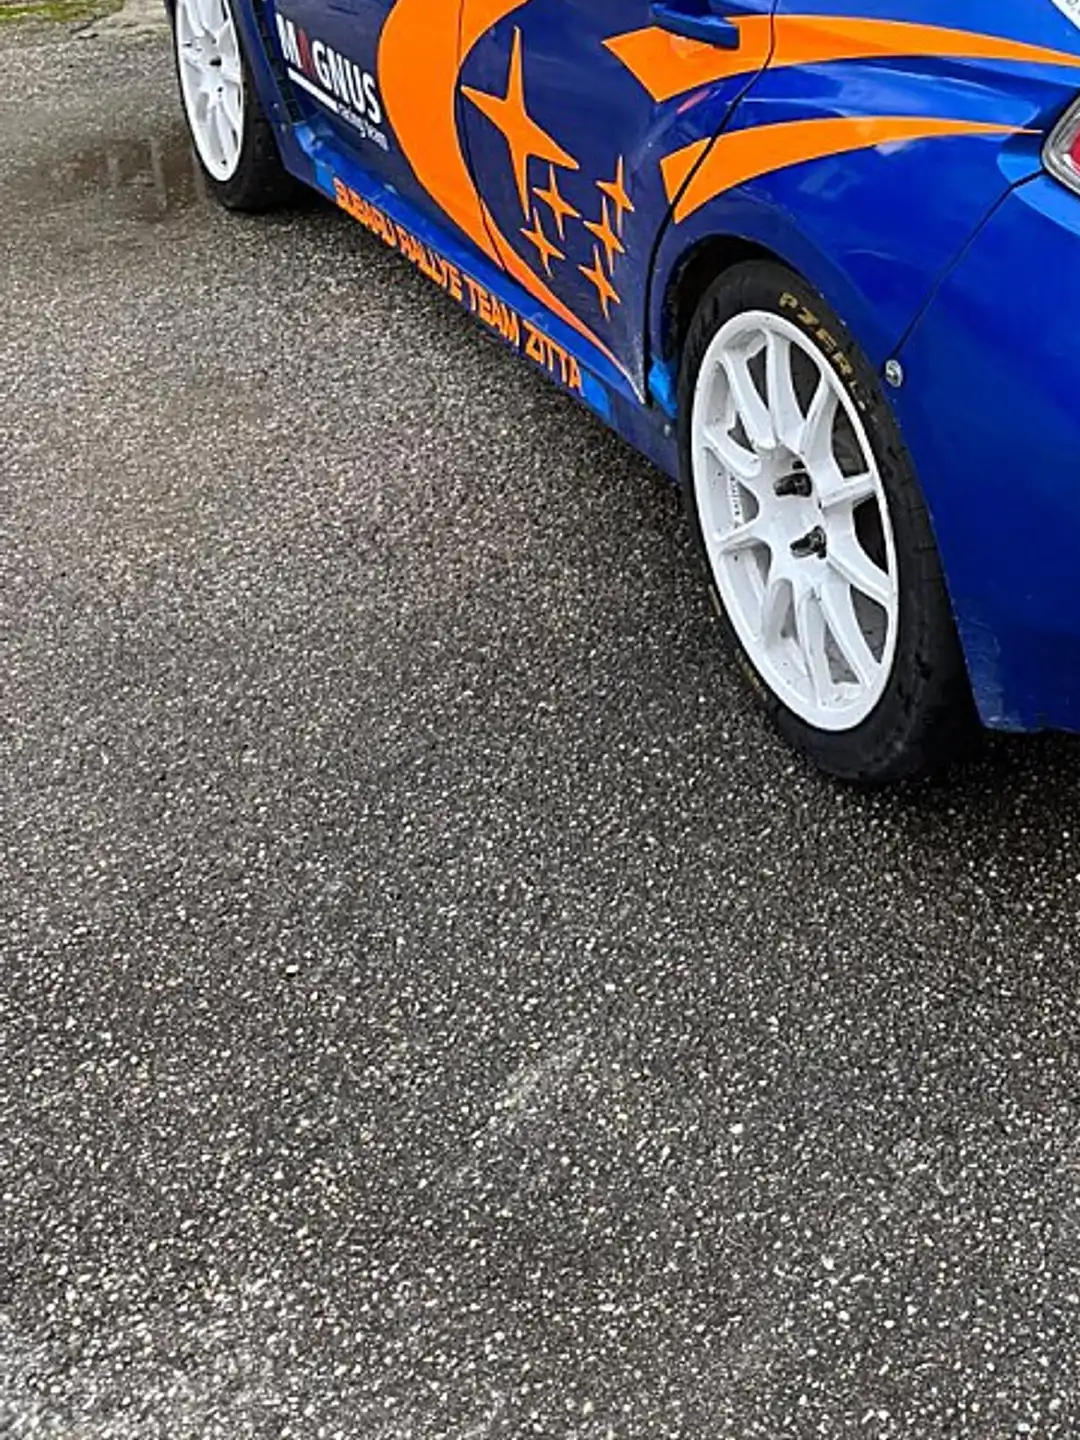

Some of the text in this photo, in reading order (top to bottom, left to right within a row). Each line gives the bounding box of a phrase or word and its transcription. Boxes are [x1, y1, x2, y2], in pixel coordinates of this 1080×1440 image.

[276, 13, 381, 124] MAGNUS
[395, 224, 462, 302] RALLYE
[461, 274, 520, 347] TEAM
[522, 319, 583, 396] ZITTA
